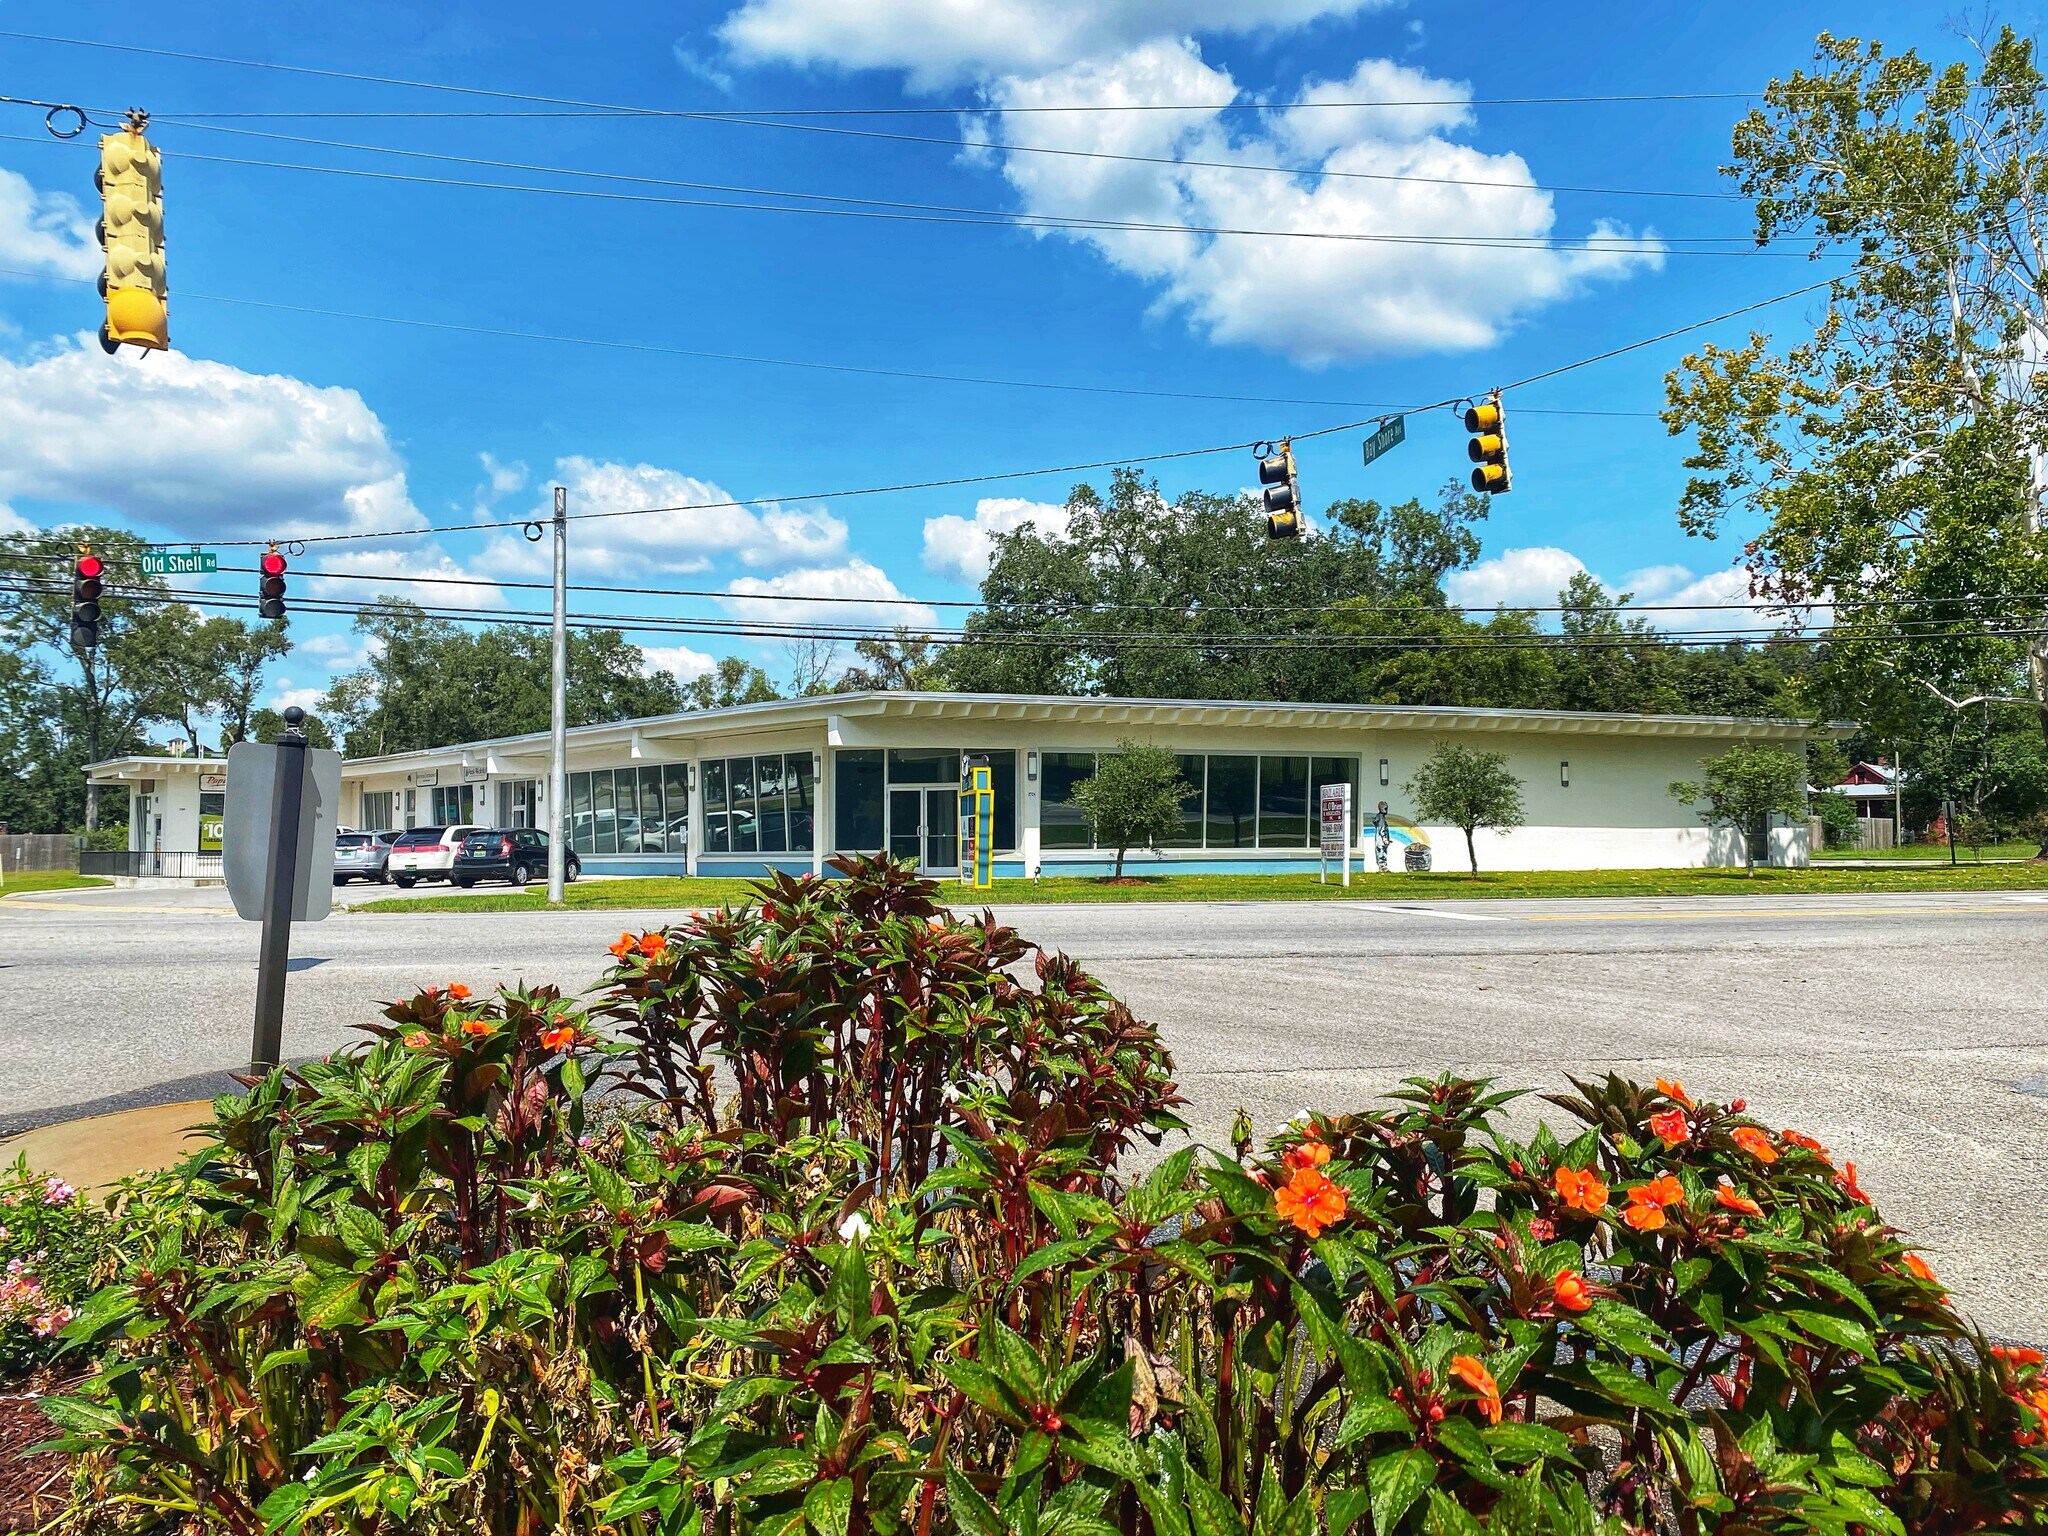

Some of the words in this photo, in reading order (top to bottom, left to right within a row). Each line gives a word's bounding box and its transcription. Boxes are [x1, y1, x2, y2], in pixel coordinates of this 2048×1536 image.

[1365, 440, 1376, 459] Bay
[1377, 428, 1394, 451] Shore
[142, 556, 164, 573] Old
[168, 555, 202, 572] Shell
[206, 558, 215, 567] Rd
